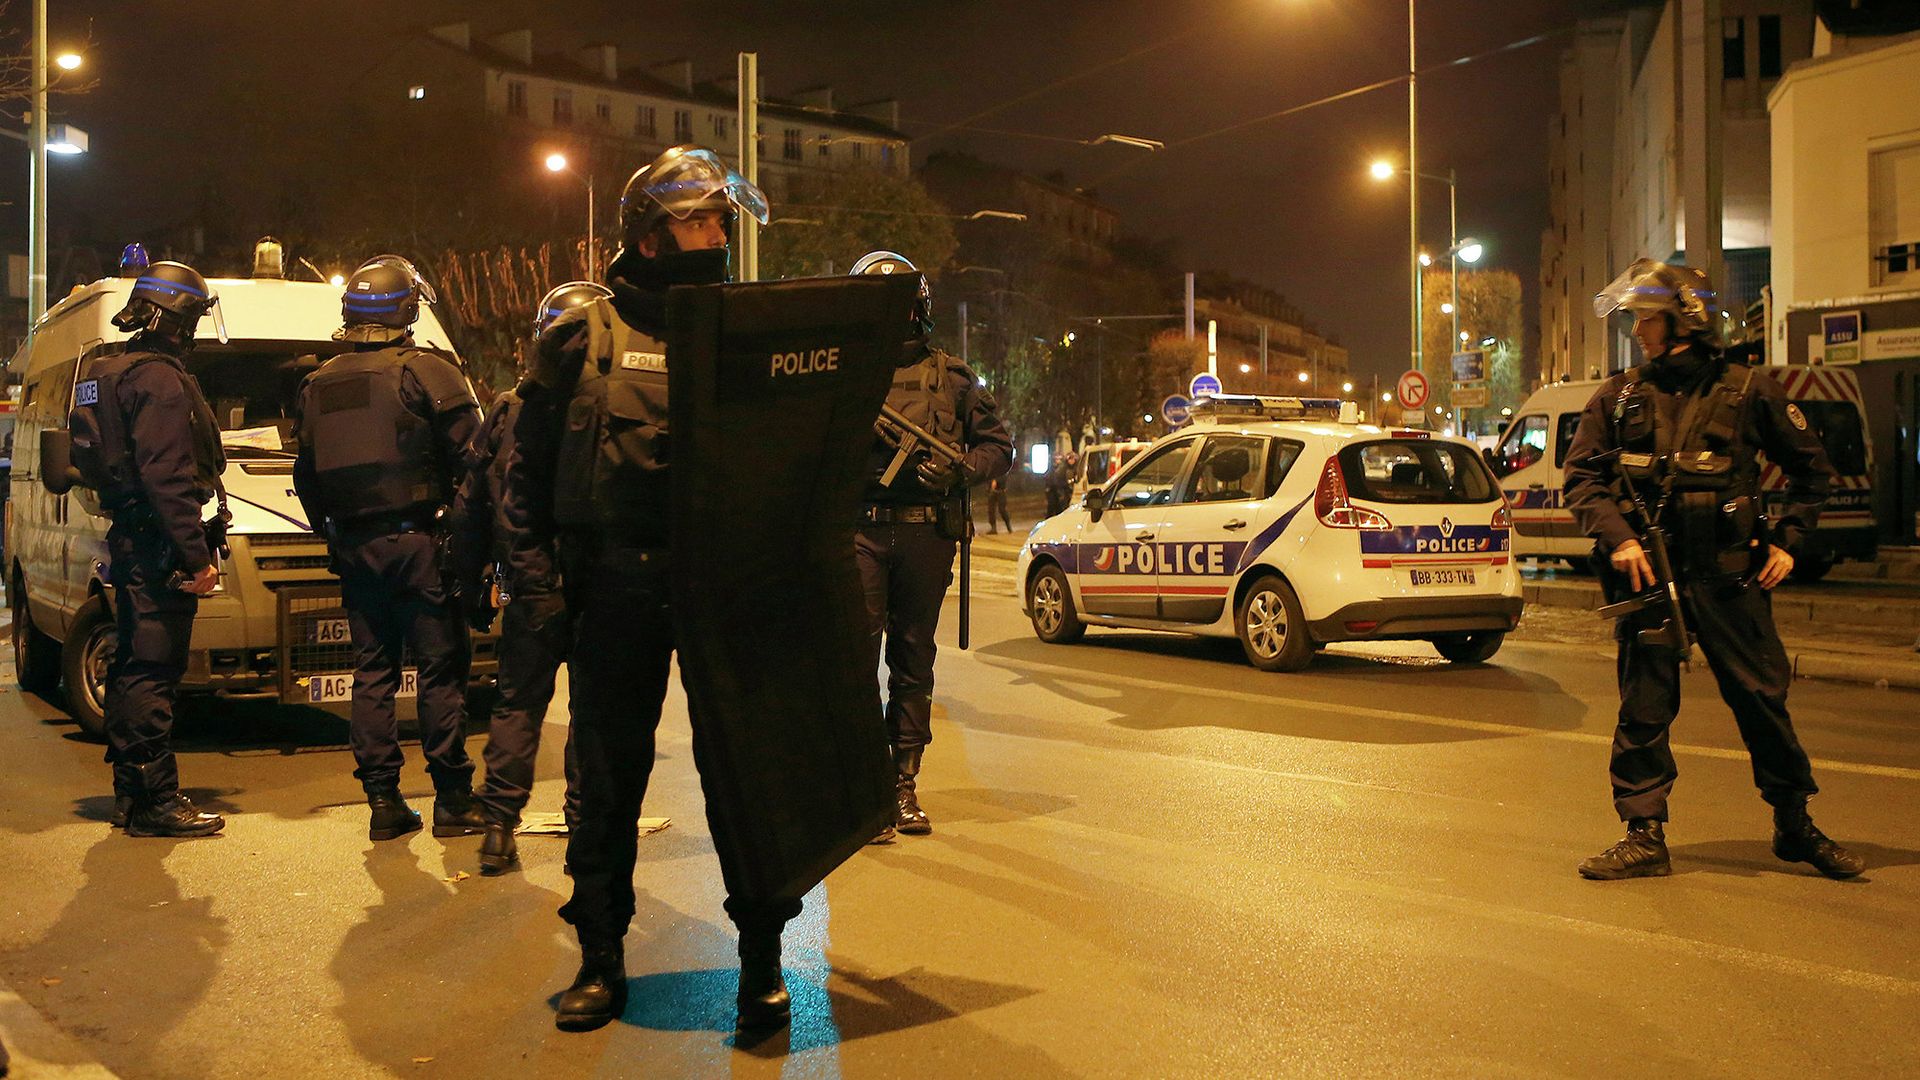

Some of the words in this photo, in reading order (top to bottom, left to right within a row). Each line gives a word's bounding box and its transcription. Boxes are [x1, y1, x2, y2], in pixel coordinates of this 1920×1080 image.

[1831, 331, 1854, 342] ASSU
[771, 347, 840, 377] POLICE
[1416, 538, 1476, 552] POLICE
[1117, 543, 1224, 574] POLICE
[1417, 570, 1469, 584] BB-333-TW
